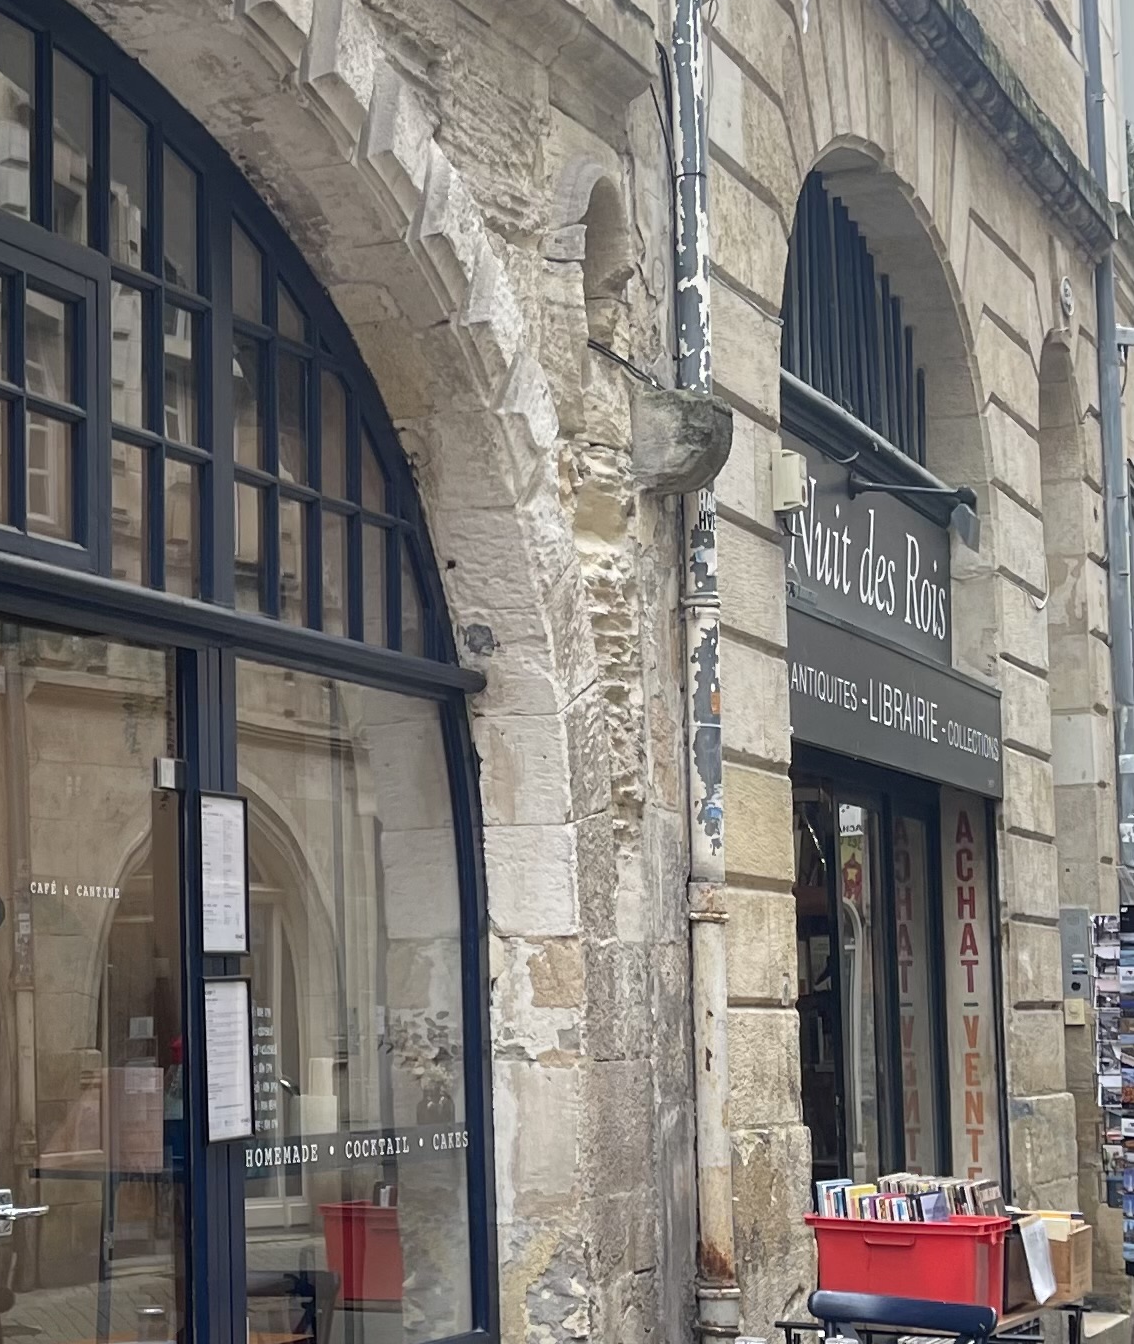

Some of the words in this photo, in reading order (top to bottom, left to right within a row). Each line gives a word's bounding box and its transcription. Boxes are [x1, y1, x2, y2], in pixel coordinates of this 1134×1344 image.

[788, 476, 851, 595] Nuit
[859, 509, 896, 616] des
[904, 533, 947, 641] Rois
[790, 661, 858, 712] ANTIQUITES
[868, 678, 939, 744] LIBRAIRIE
[947, 719, 1000, 762] COLLECTIONS
[30, 879, 57, 895] CAFÉ
[76, 884, 121, 900] CANTINE
[245, 1143, 318, 1168] HOMEMADE
[345, 1136, 410, 1159] COCKTAIL
[432, 1130, 470, 1151] CAKES
